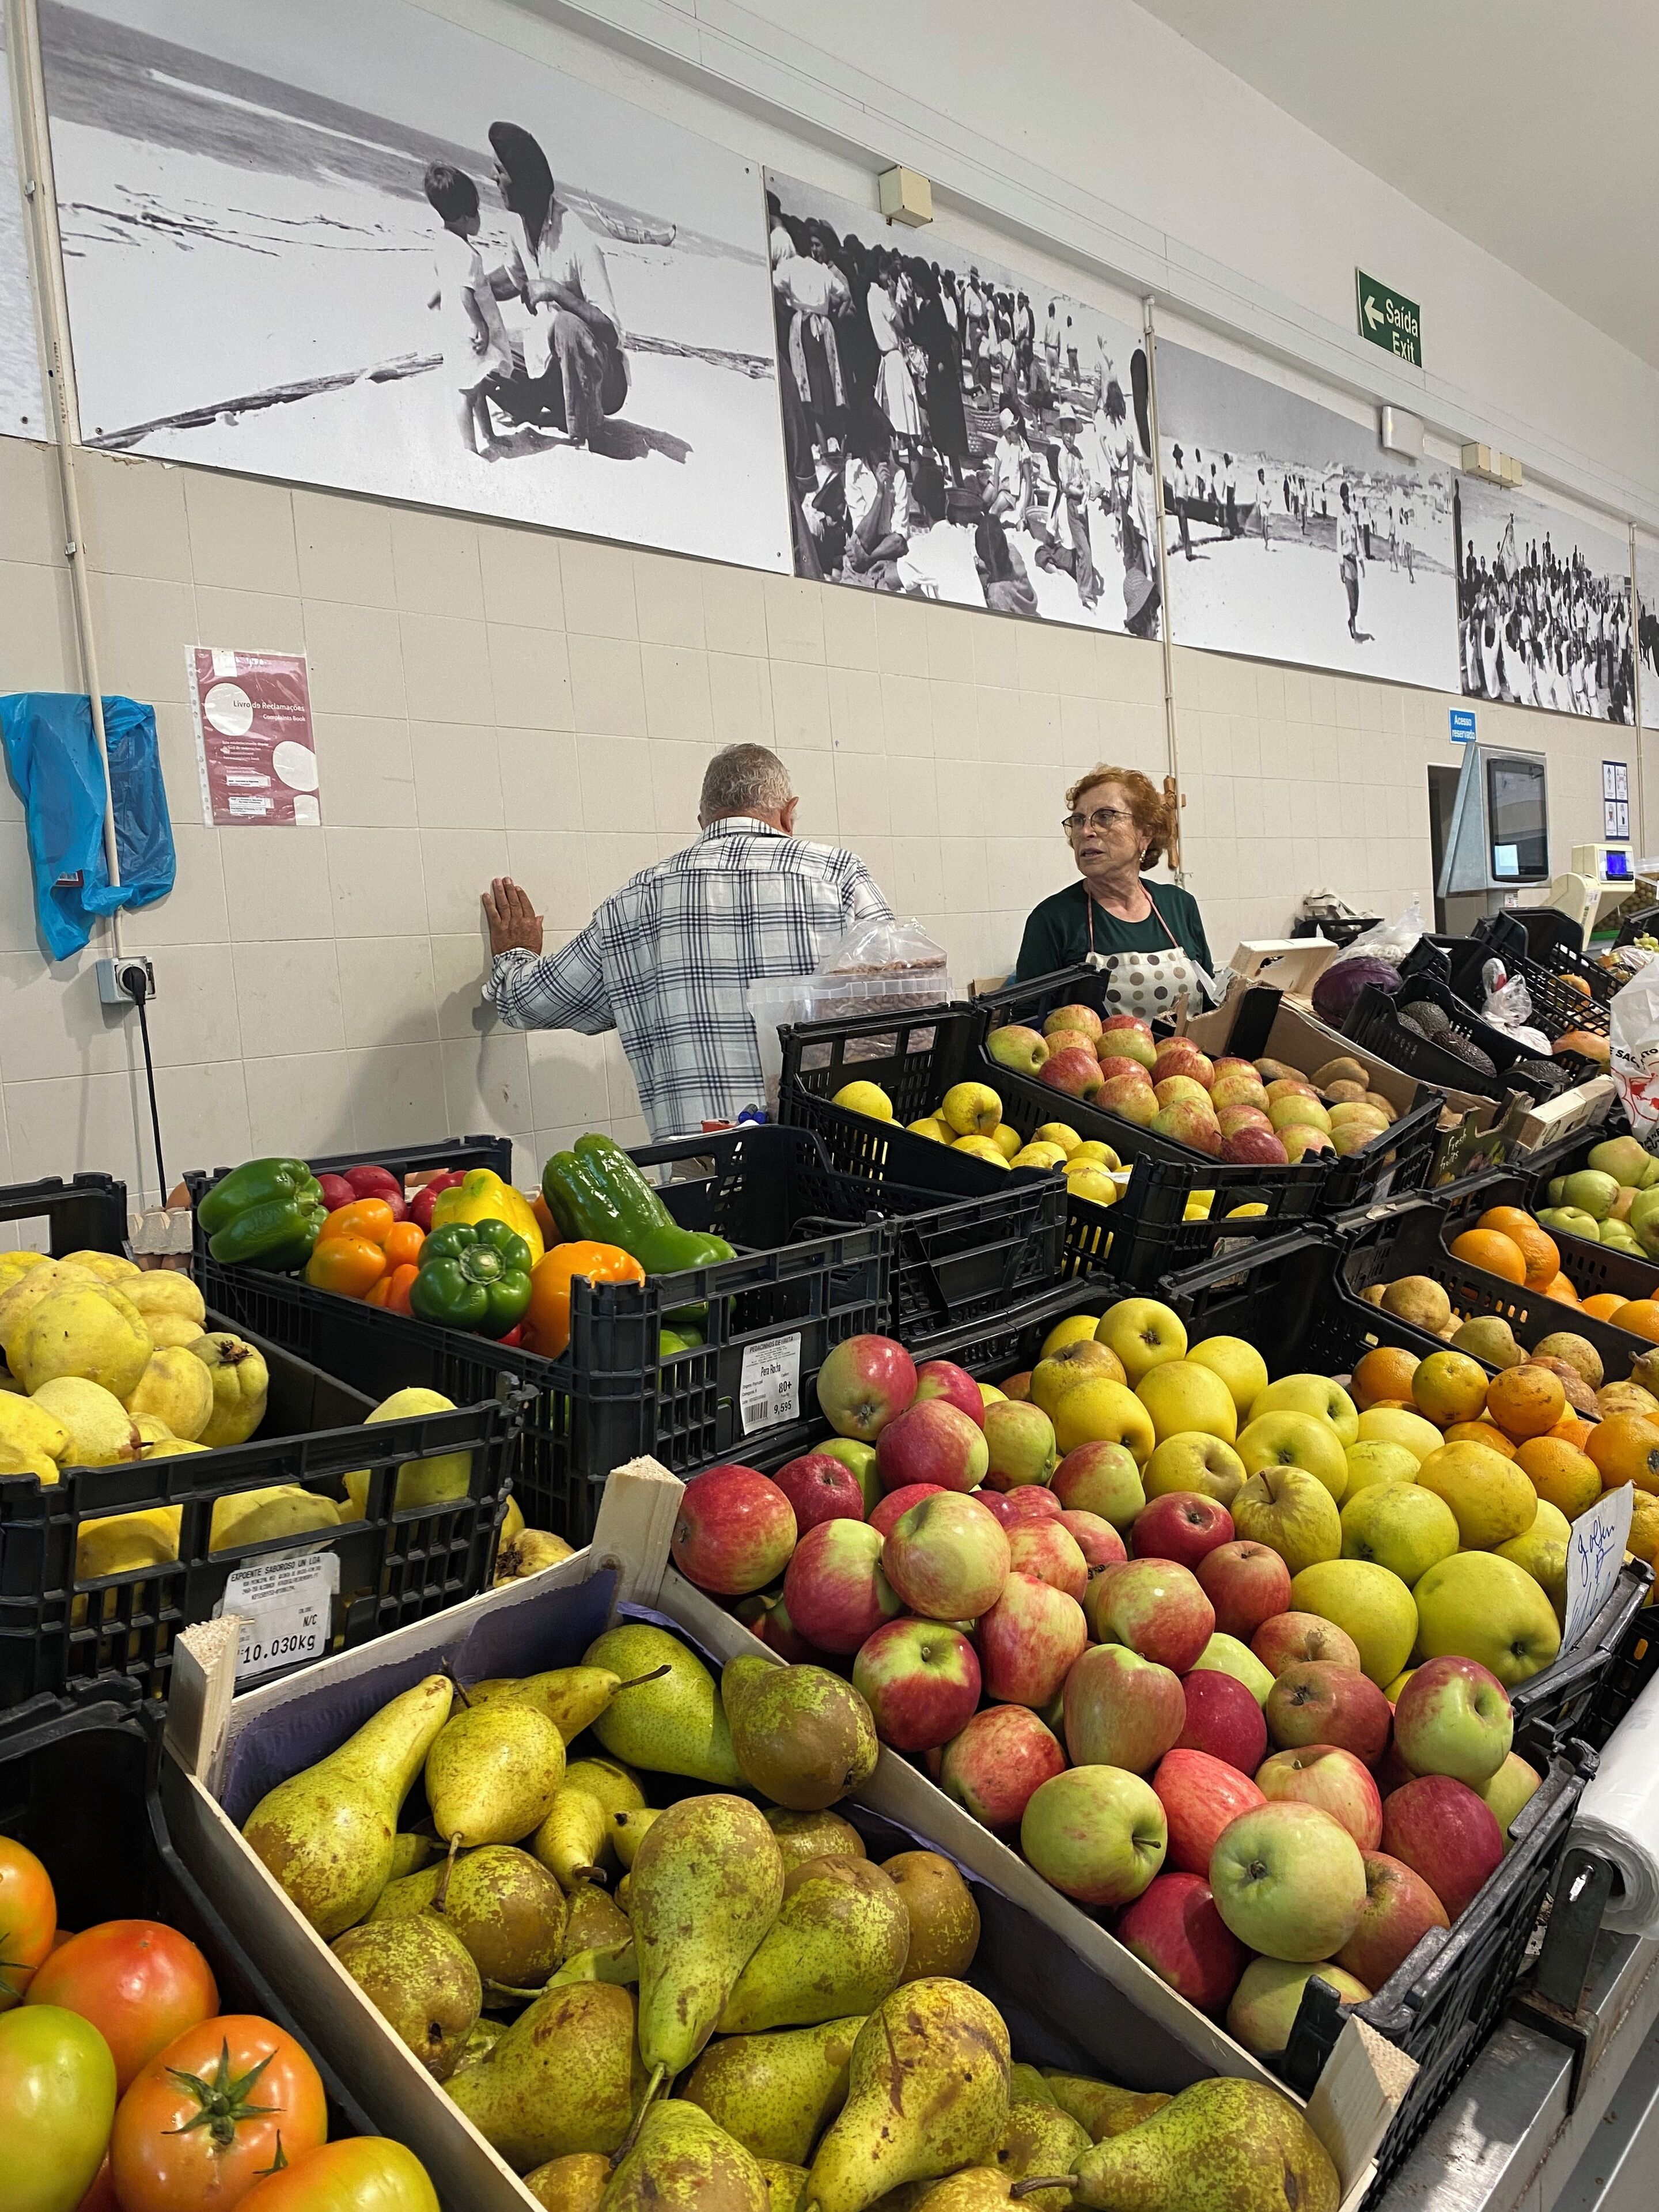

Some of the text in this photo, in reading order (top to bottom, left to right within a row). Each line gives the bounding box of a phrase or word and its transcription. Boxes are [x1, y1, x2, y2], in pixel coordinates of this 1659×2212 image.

[1385, 298, 1418, 338] Saída
[1392, 331, 1415, 363] Exit
[262, 702, 305, 712] Reclamações
[1454, 714, 1472, 726] Acesso
[1448, 1128, 1467, 1155] fresh
[1440, 1150, 1459, 1175] fruits
[761, 1362, 781, 1377] Pera Rocha
[779, 1381, 792, 1393] 80+
[774, 1400, 792, 1415] 9,595
[231, 1568, 262, 1581] EXPOENTE
[265, 1561, 296, 1574] SABOROSO
[298, 1558, 306, 1567] UN
[303, 1614, 317, 1627] N/C
[243, 1635, 316, 1664] 10.030kg
